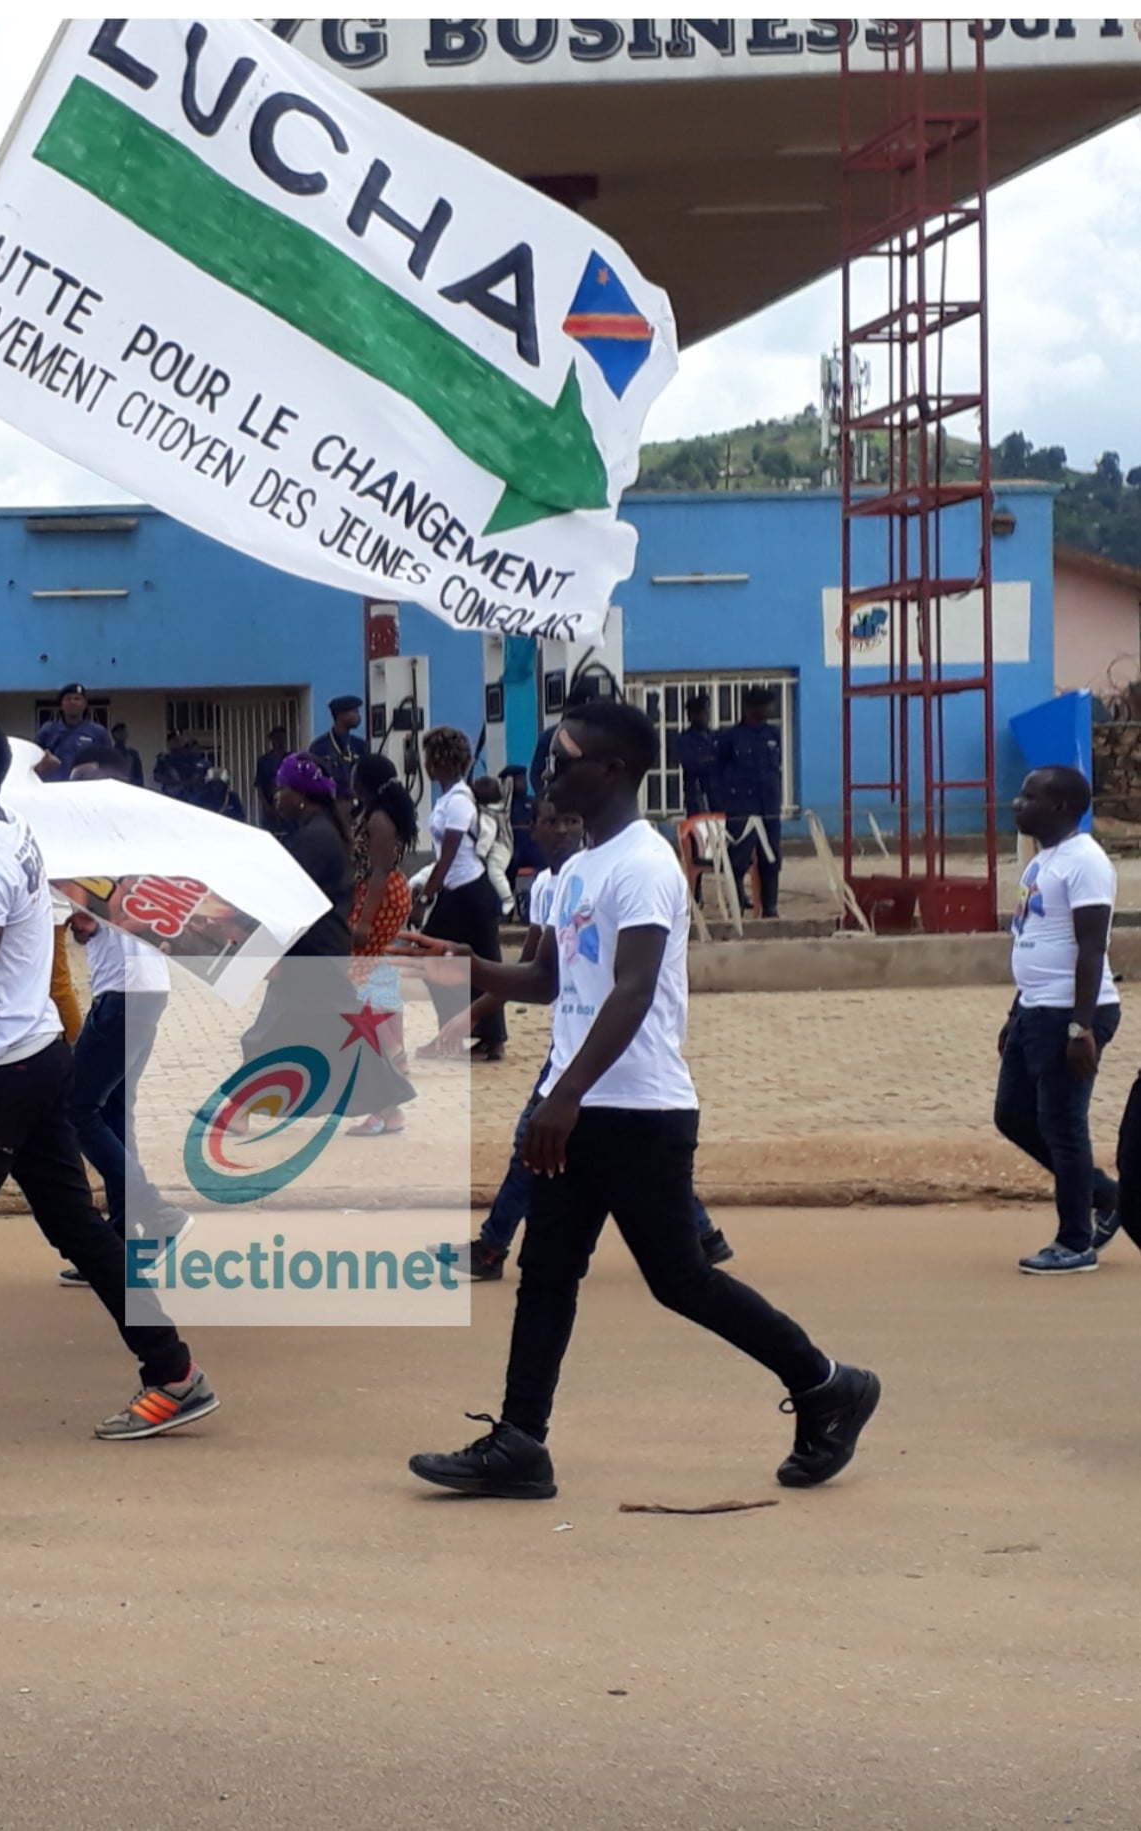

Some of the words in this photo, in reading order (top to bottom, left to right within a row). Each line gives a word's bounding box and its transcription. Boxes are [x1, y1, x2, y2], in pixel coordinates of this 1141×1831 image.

[88, 19, 540, 367] LUCHA
[116, 391, 247, 487] CITOYEN
[249, 468, 316, 528] DES
[319, 506, 431, 585] JEUNES
[120, 323, 230, 414] POUR
[238, 393, 299, 450] LE
[312, 434, 576, 600] CHANGEMENT
